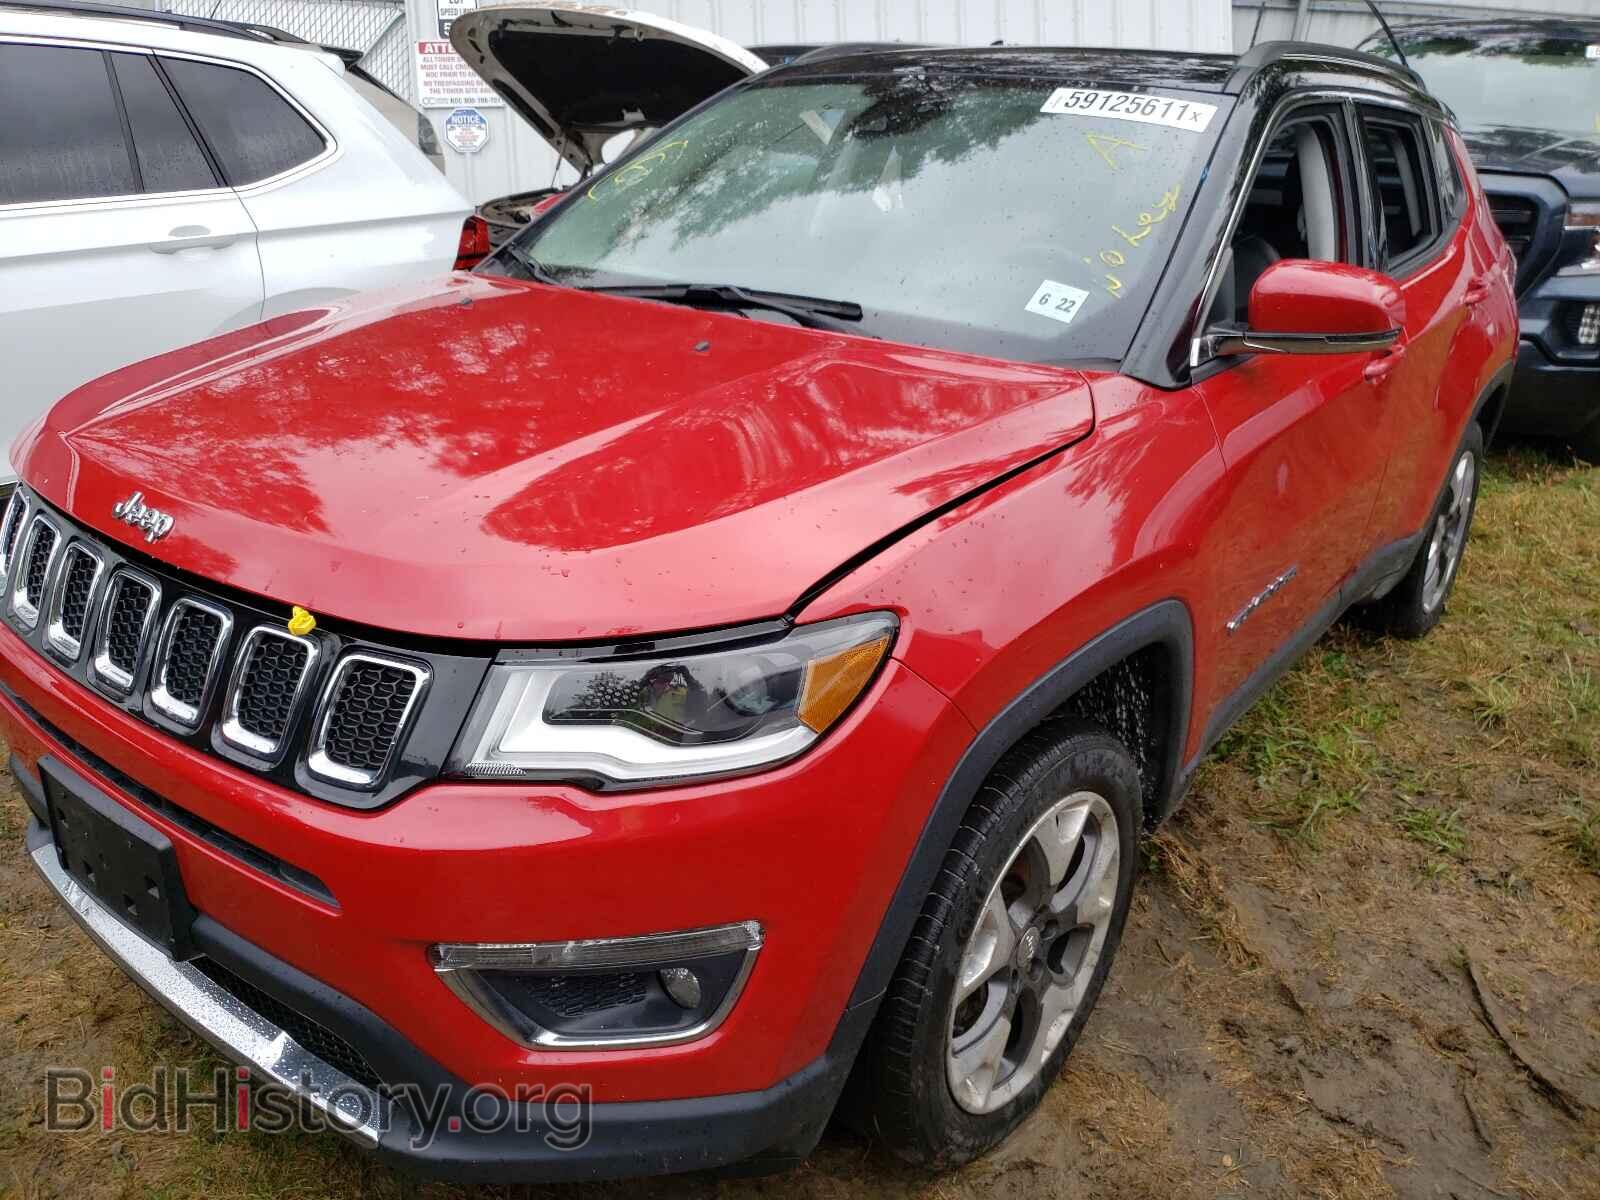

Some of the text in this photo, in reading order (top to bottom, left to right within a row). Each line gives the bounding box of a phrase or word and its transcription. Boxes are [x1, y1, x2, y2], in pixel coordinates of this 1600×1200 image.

[424, 43, 456, 54] ATTE
[451, 115, 481, 124] NOTICE
[1038, 292, 1077, 313] 6 22
[111, 491, 176, 543] Jeep
